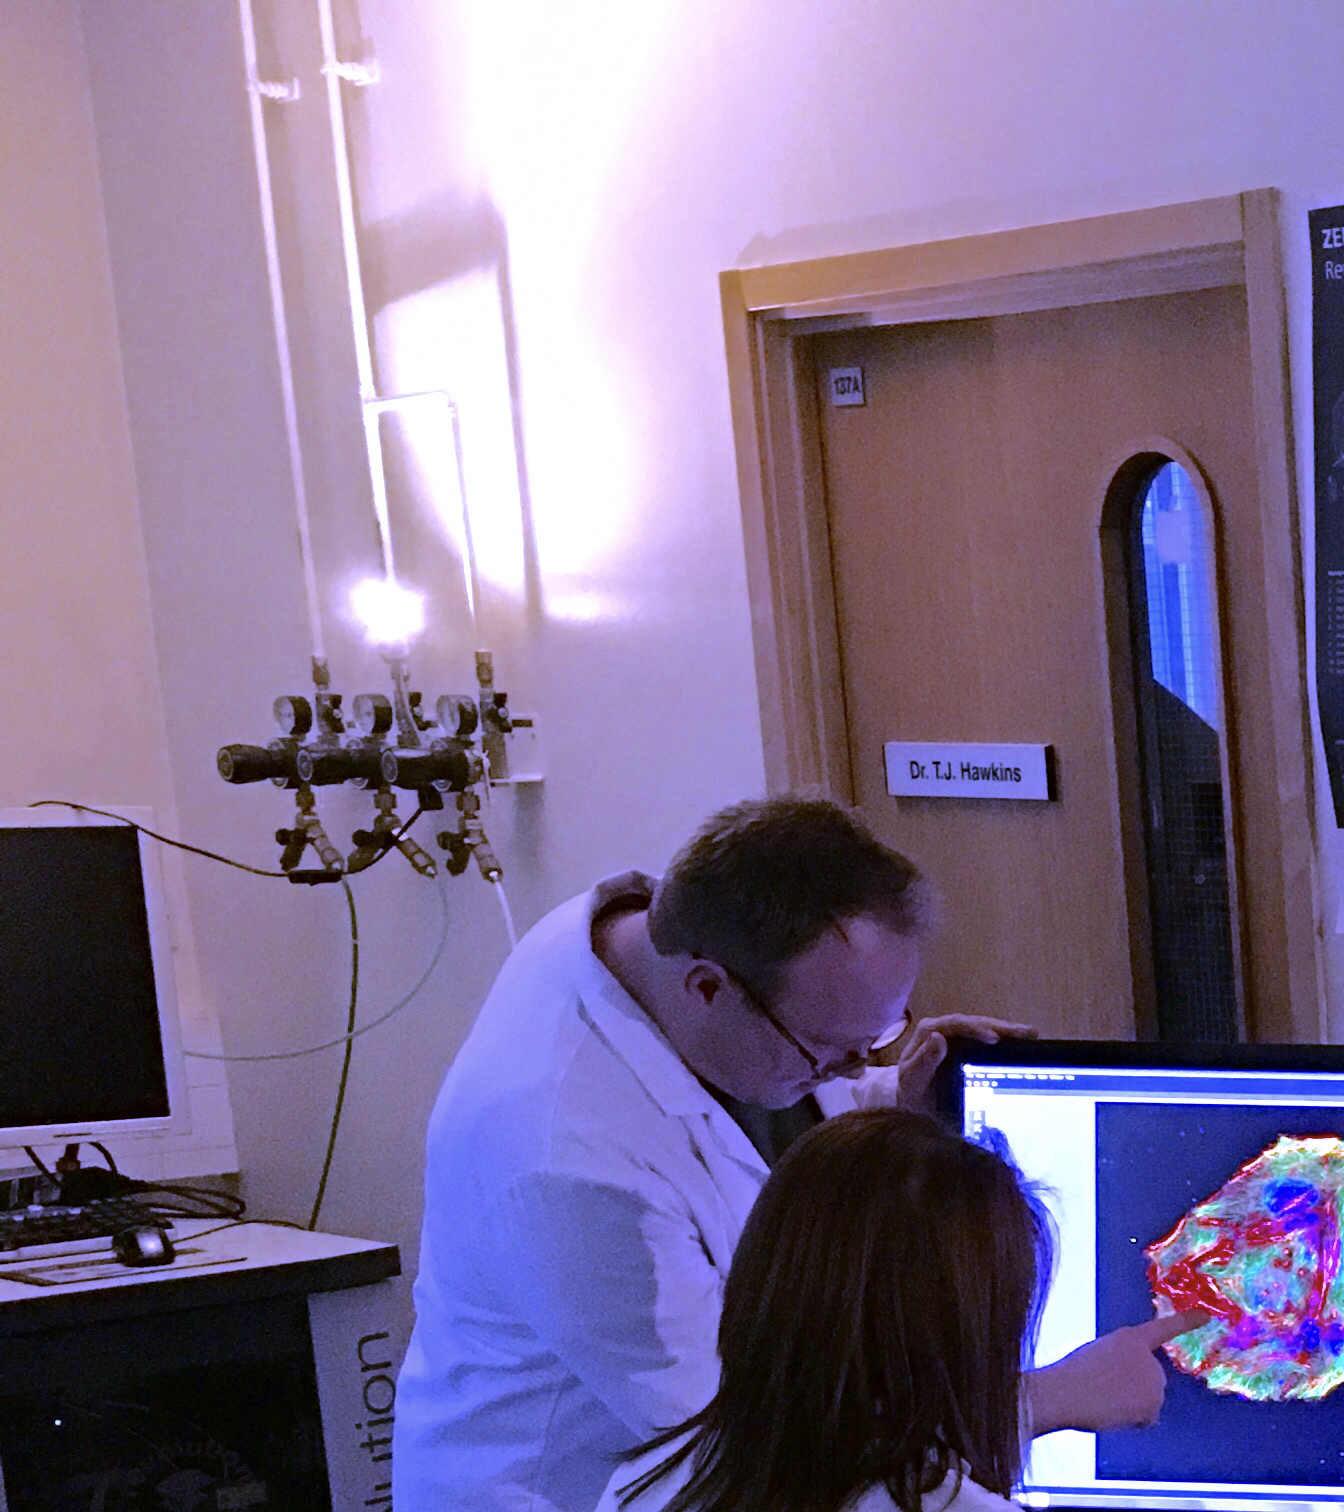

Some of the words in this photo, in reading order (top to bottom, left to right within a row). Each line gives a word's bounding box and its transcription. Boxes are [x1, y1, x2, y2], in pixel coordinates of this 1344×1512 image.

[910, 761, 929, 780] Dr.
[932, 761, 956, 781] T.J.
[960, 762, 1022, 782] Hawkins
